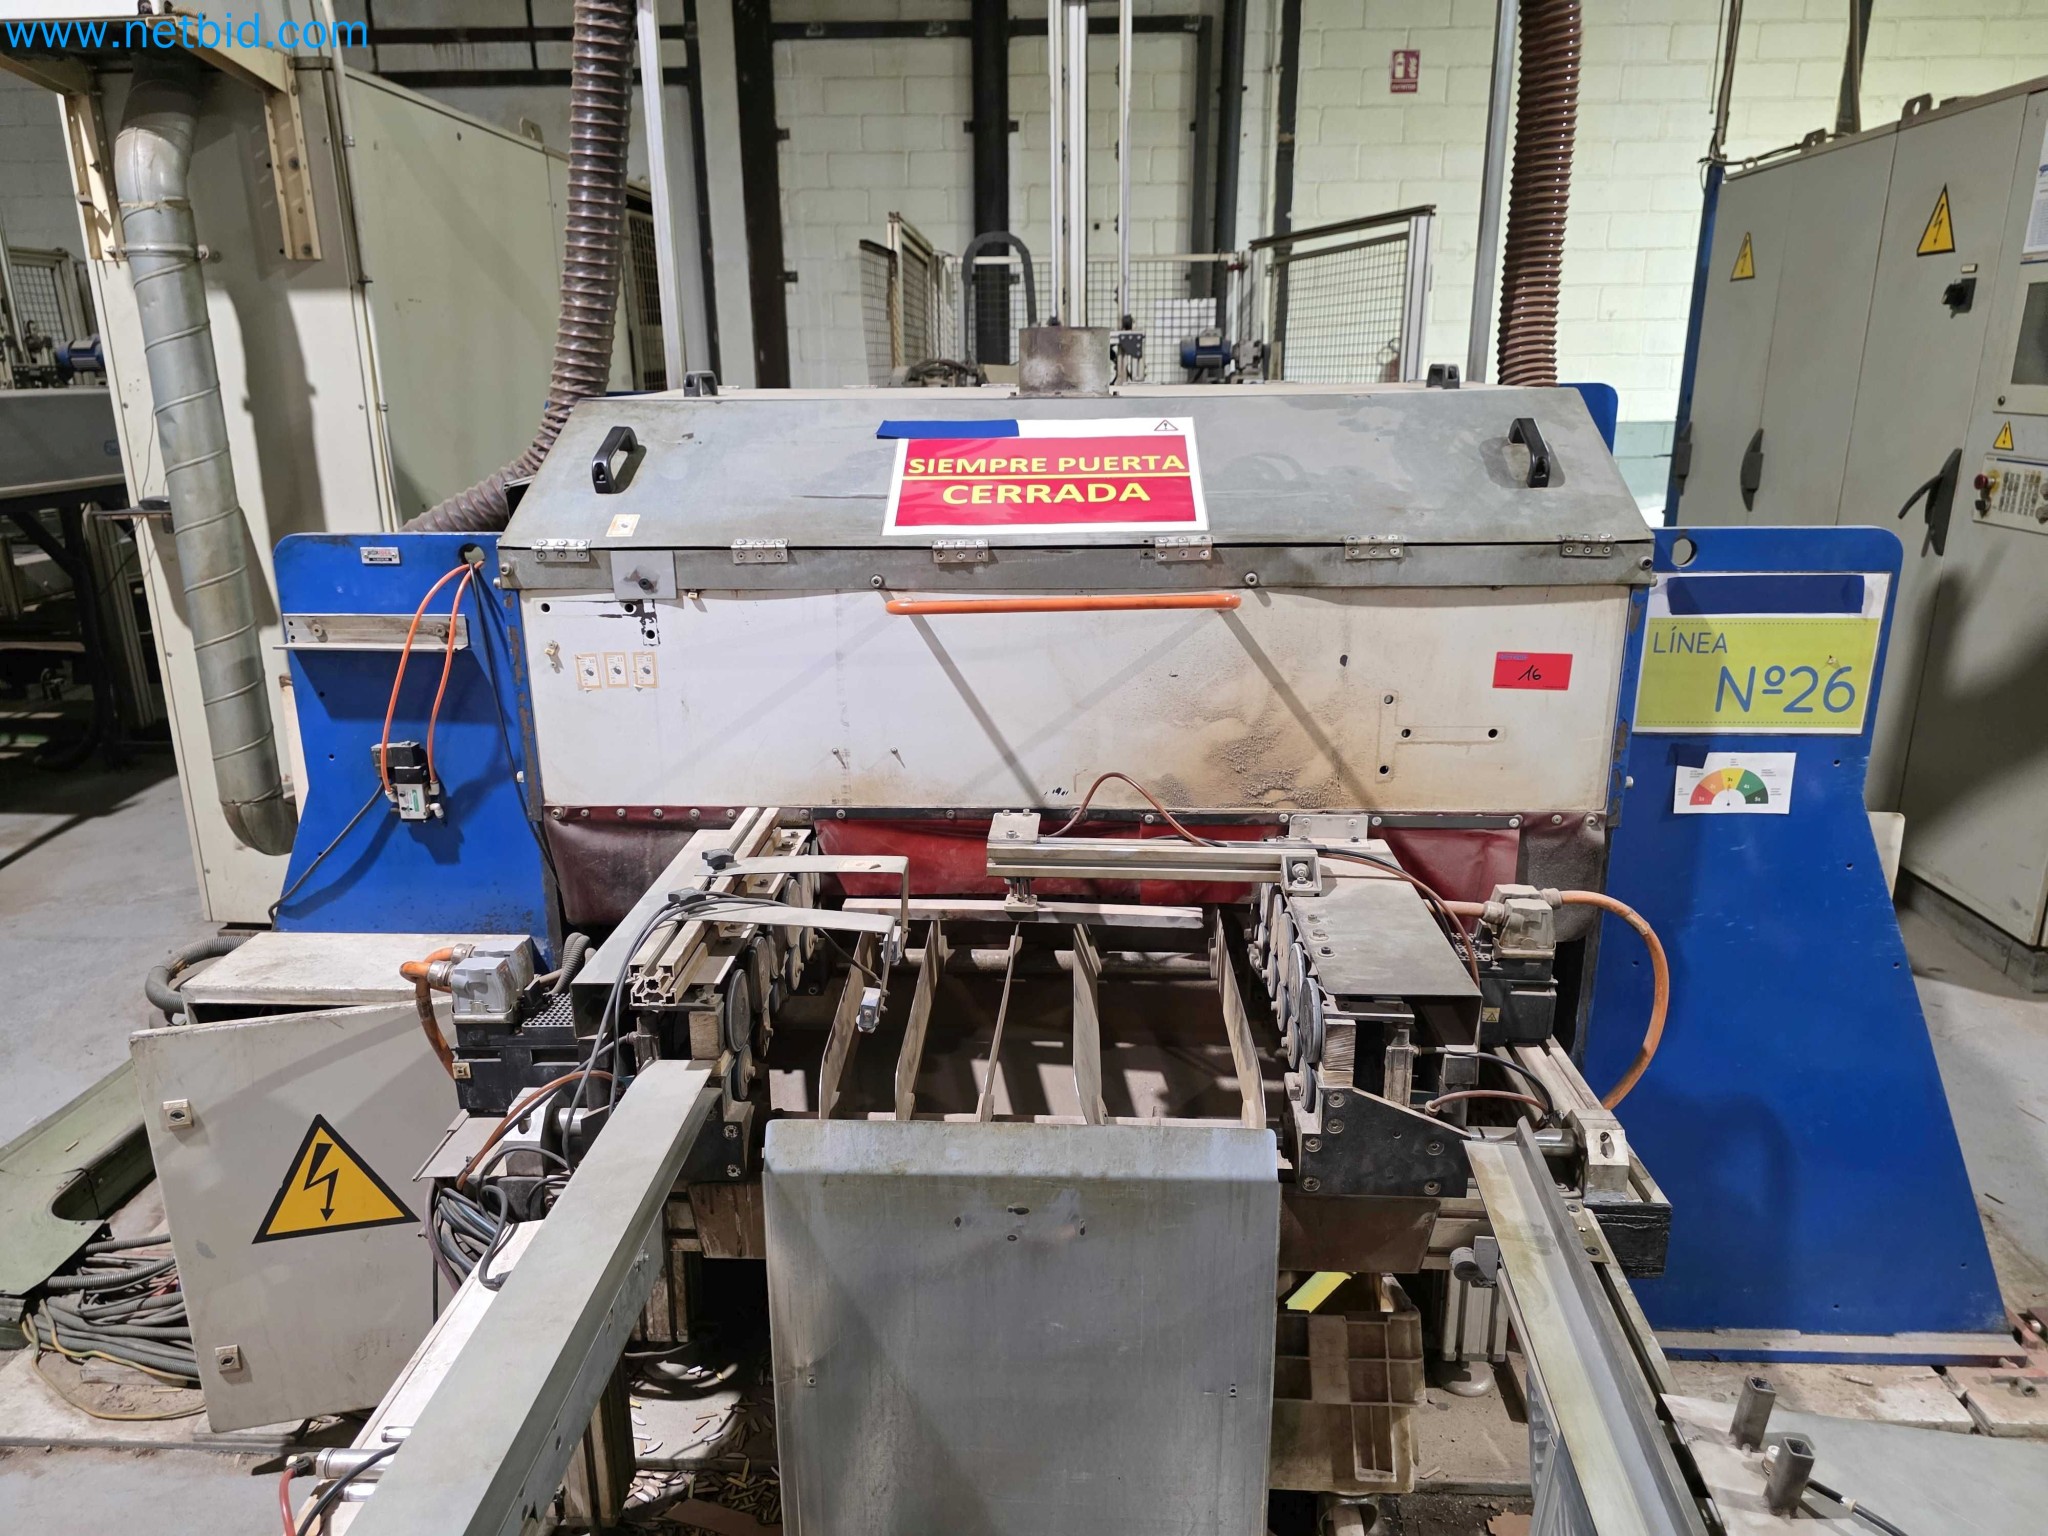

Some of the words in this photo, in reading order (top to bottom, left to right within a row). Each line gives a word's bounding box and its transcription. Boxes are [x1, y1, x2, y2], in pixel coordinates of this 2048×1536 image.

[908, 457, 1048, 474] SIEMPRE
[1057, 454, 1186, 473] PUERTA
[941, 482, 1151, 505] CERRADA
[1653, 626, 1728, 654] LÍNEA
[1517, 664, 1542, 681] 16
[1715, 665, 1856, 713] Nº26
